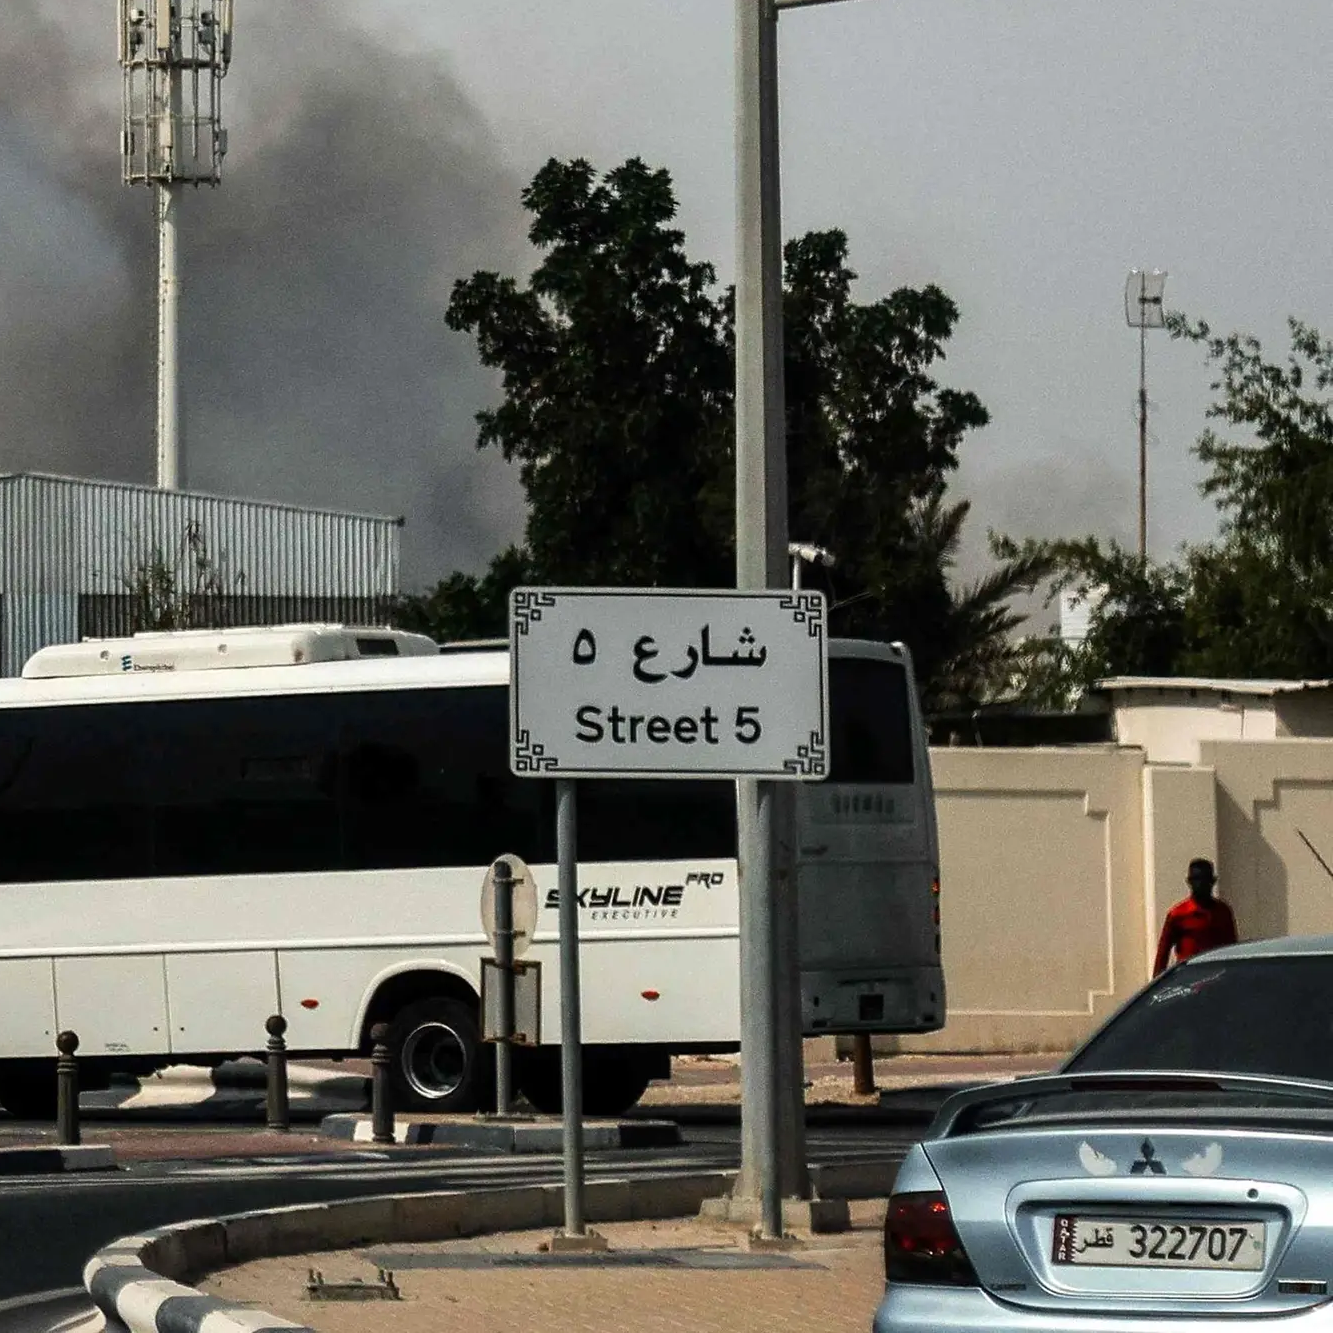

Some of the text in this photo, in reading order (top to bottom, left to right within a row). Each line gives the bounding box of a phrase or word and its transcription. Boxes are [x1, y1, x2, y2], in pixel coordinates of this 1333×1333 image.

[573, 624, 767, 684] شارع ٥
[576, 705, 762, 744] Street 5
[686, 872, 724, 889] PRO
[591, 909, 678, 920] EXECUTIVE
[1058, 1219, 1070, 1260] QATAR
[1076, 1227, 1114, 1253] قطر
[1129, 1224, 1248, 1262] 322707
